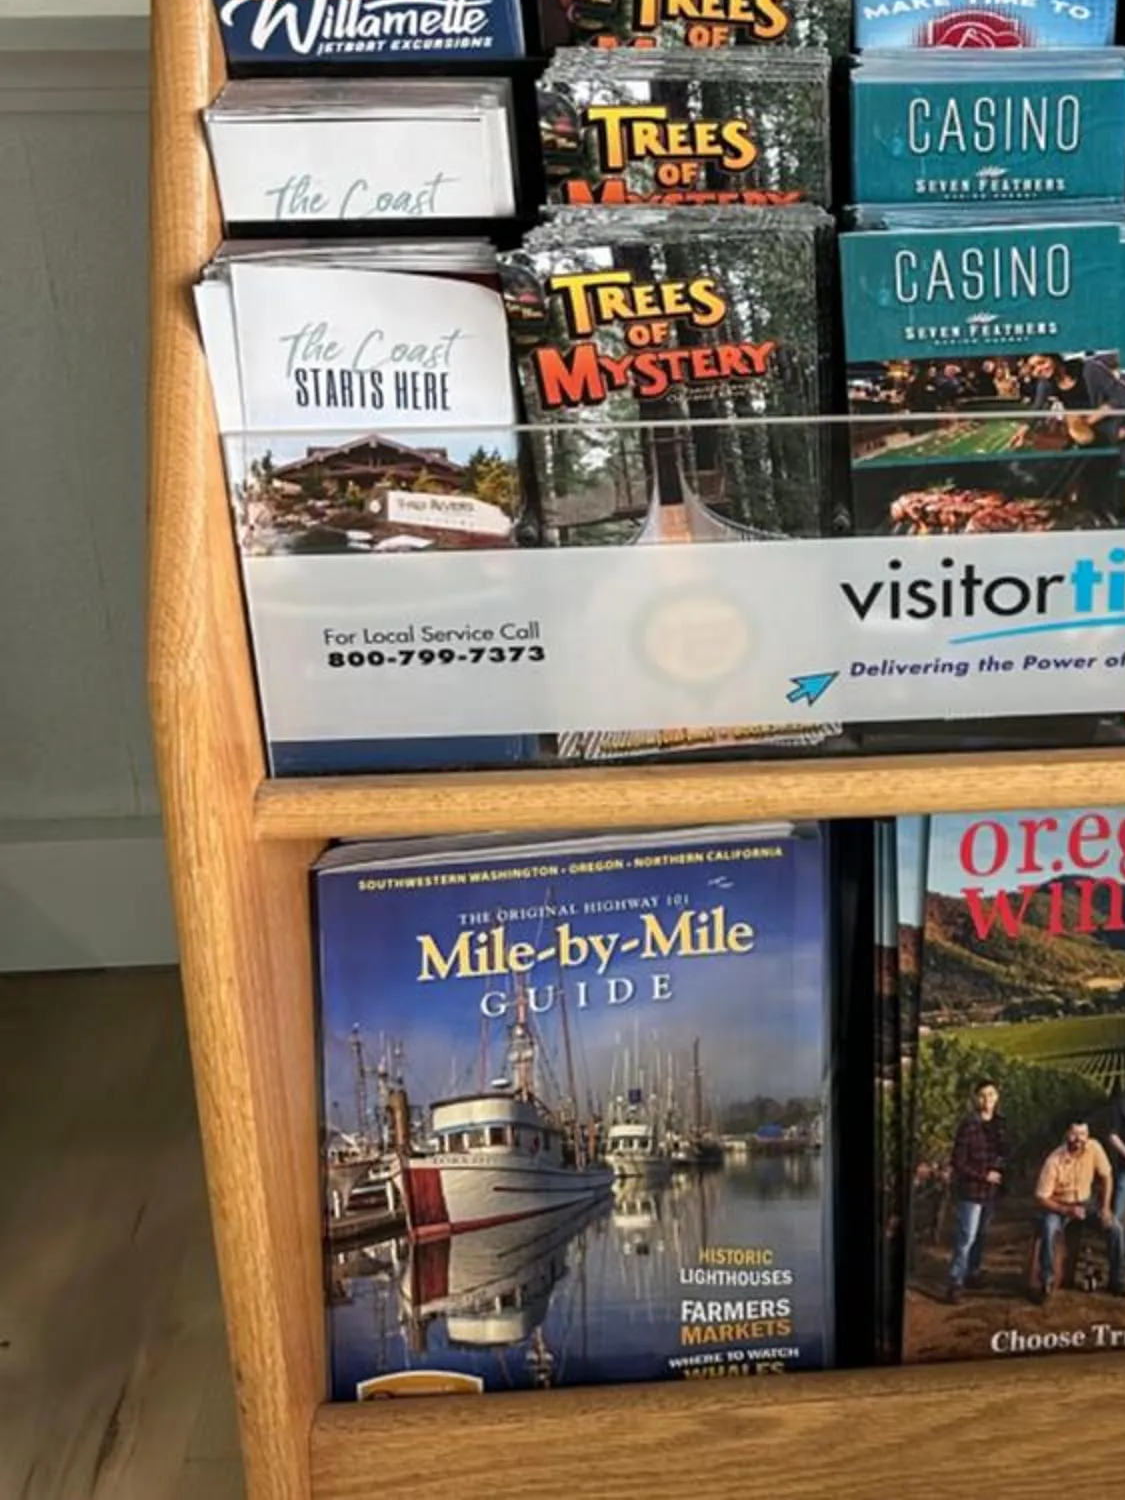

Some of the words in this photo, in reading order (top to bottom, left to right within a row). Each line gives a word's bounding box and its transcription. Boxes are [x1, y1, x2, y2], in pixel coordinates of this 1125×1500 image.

[1053, 0, 1090, 19] TO
[909, 95, 1080, 153] CASINO
[915, 177, 970, 192] SEVEN
[977, 177, 1066, 193] FEATHERS
[628, 322, 670, 348] OF
[534, 340, 775, 407] MYSTERY
[295, 368, 385, 408] STARTS
[394, 369, 451, 411] HERE
[324, 628, 356, 647] For
[363, 625, 414, 646] Local
[421, 623, 493, 642] Service
[500, 621, 540, 640] Call
[328, 645, 546, 669] 800-799-7373
[850, 659, 970, 678] Delivering
[978, 656, 1015, 673] the
[1023, 653, 1098, 672] Power
[358, 872, 466, 891] SOUTHWESTERN
[469, 864, 559, 884] WASHINGTON
[569, 858, 625, 875] OREGON
[634, 852, 704, 870] NORTHERN
[706, 845, 784, 861] CALIFORNIA
[459, 912, 492, 926] THE
[496, 902, 578, 923] ORIGINAL
[583, 895, 660, 915] HIGHWAY
[666, 893, 691, 908] 101
[417, 905, 755, 982] Mile-by-Mile
[480, 973, 674, 1018] GUIDE
[699, 1247, 774, 1266] HISTORIC
[680, 1268, 792, 1288] LIGHTHOUSES
[681, 1297, 792, 1322] FARMERS
[681, 1320, 792, 1346] MARKETS
[990, 1327, 1086, 1353] Choose
[669, 1351, 725, 1370] WHERE
[728, 1349, 746, 1362] TO
[748, 1346, 800, 1360] WATCH
